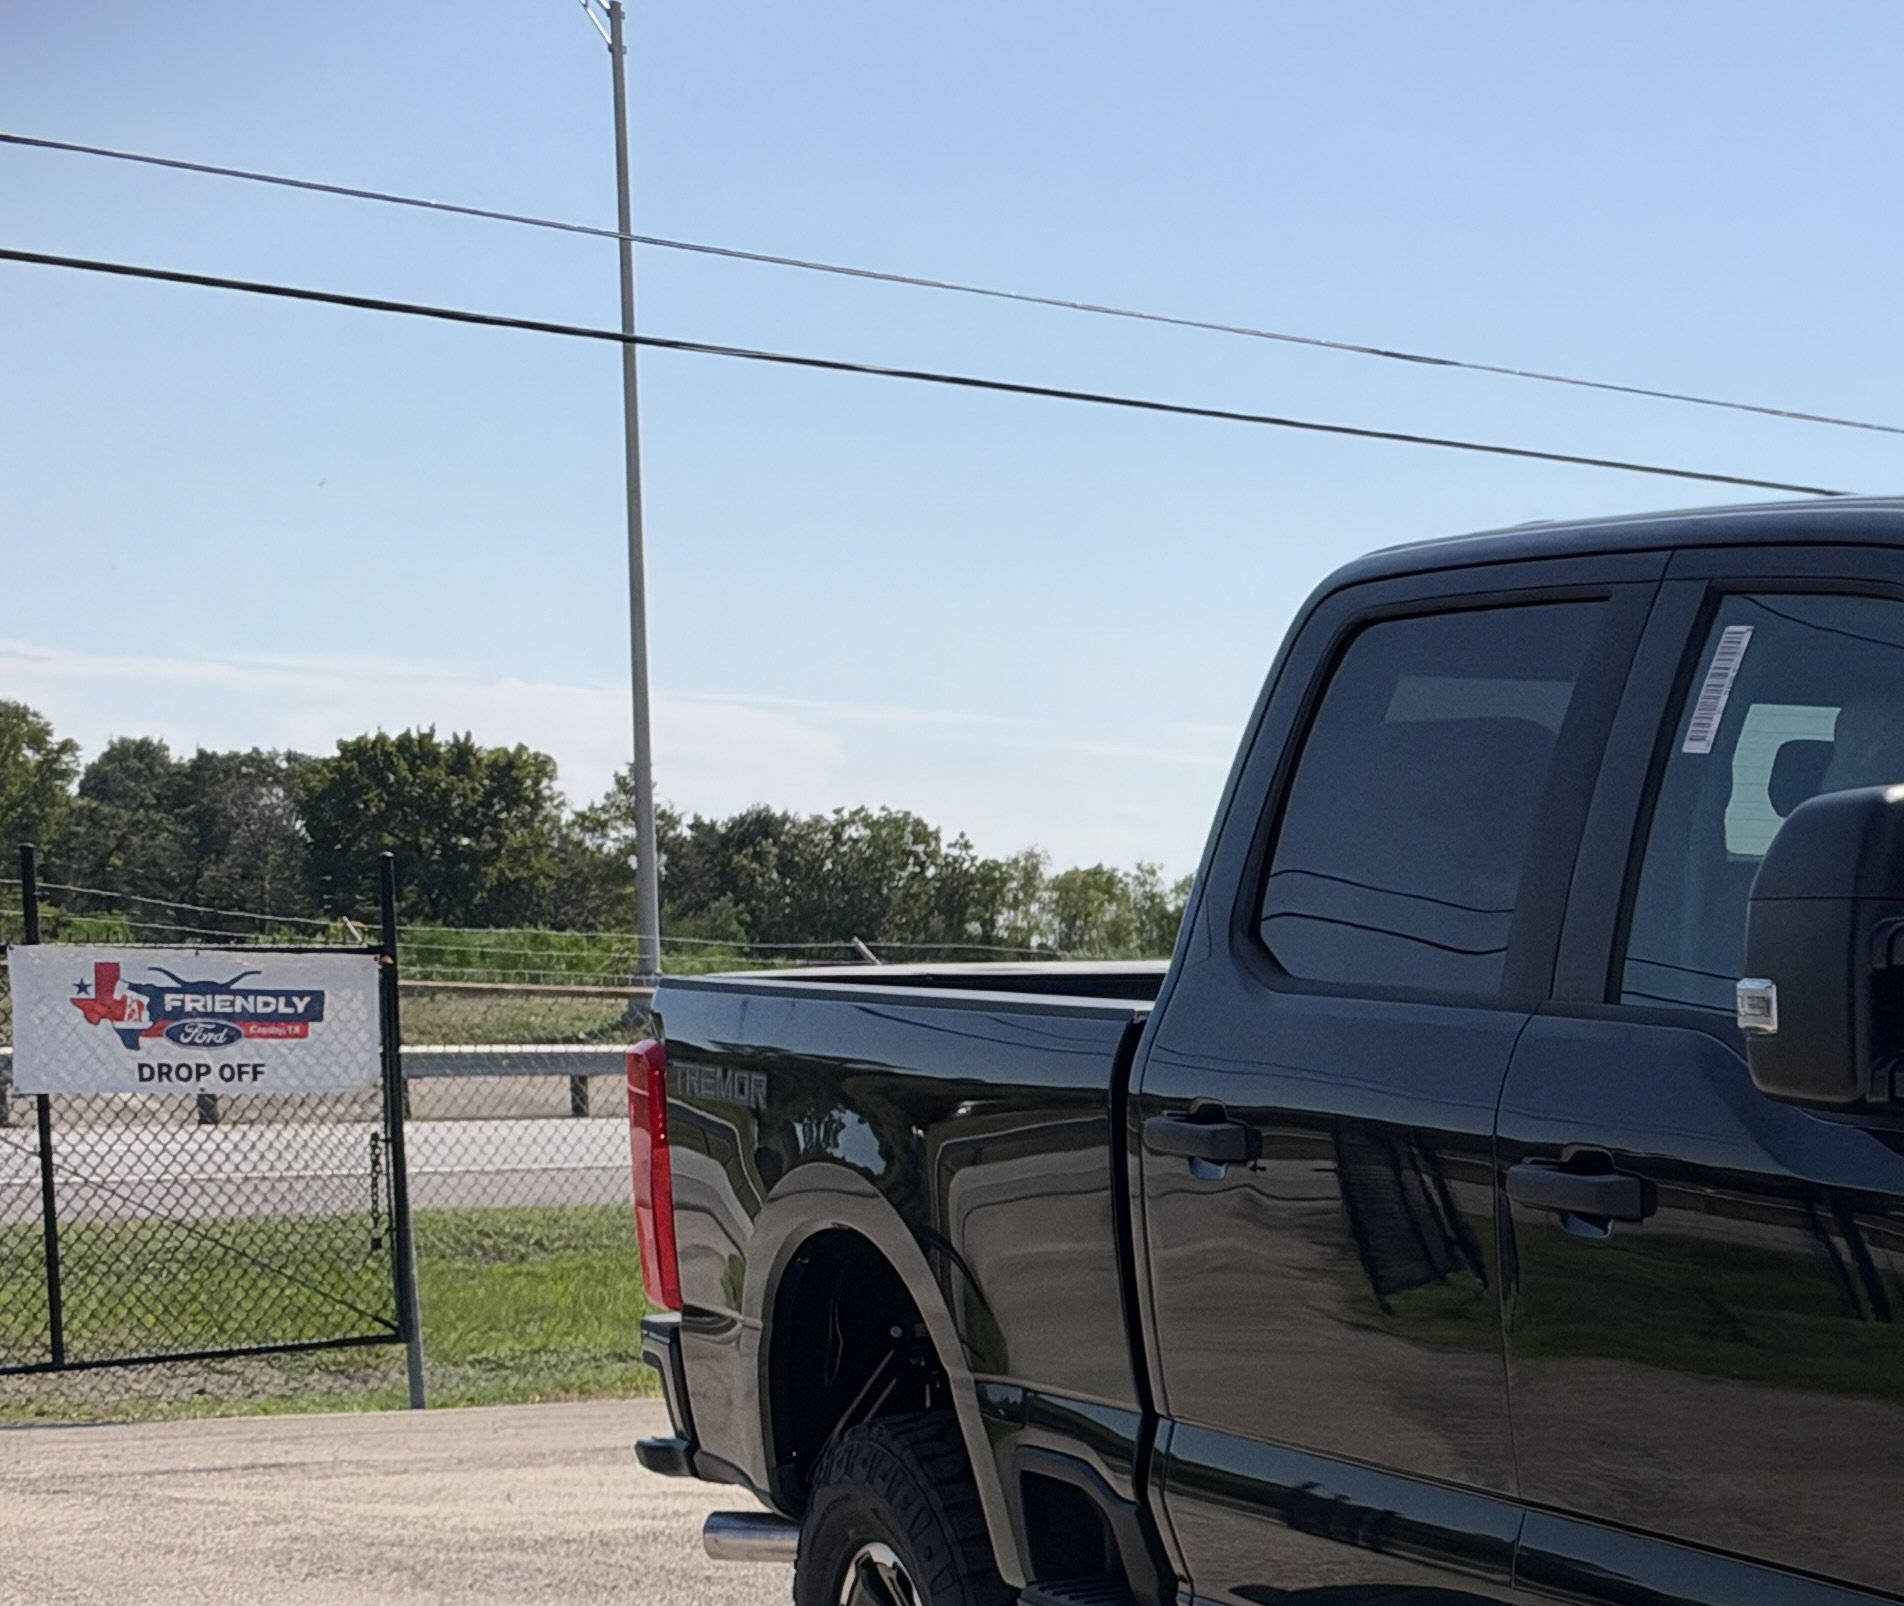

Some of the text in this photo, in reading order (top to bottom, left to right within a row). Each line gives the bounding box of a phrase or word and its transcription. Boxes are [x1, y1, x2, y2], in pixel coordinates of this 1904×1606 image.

[163, 993, 312, 1014] FRIENDLY
[179, 1021, 229, 1045] Ford
[137, 1062, 267, 1083] DROP OFF
[672, 1060, 768, 1111] TREMOR
